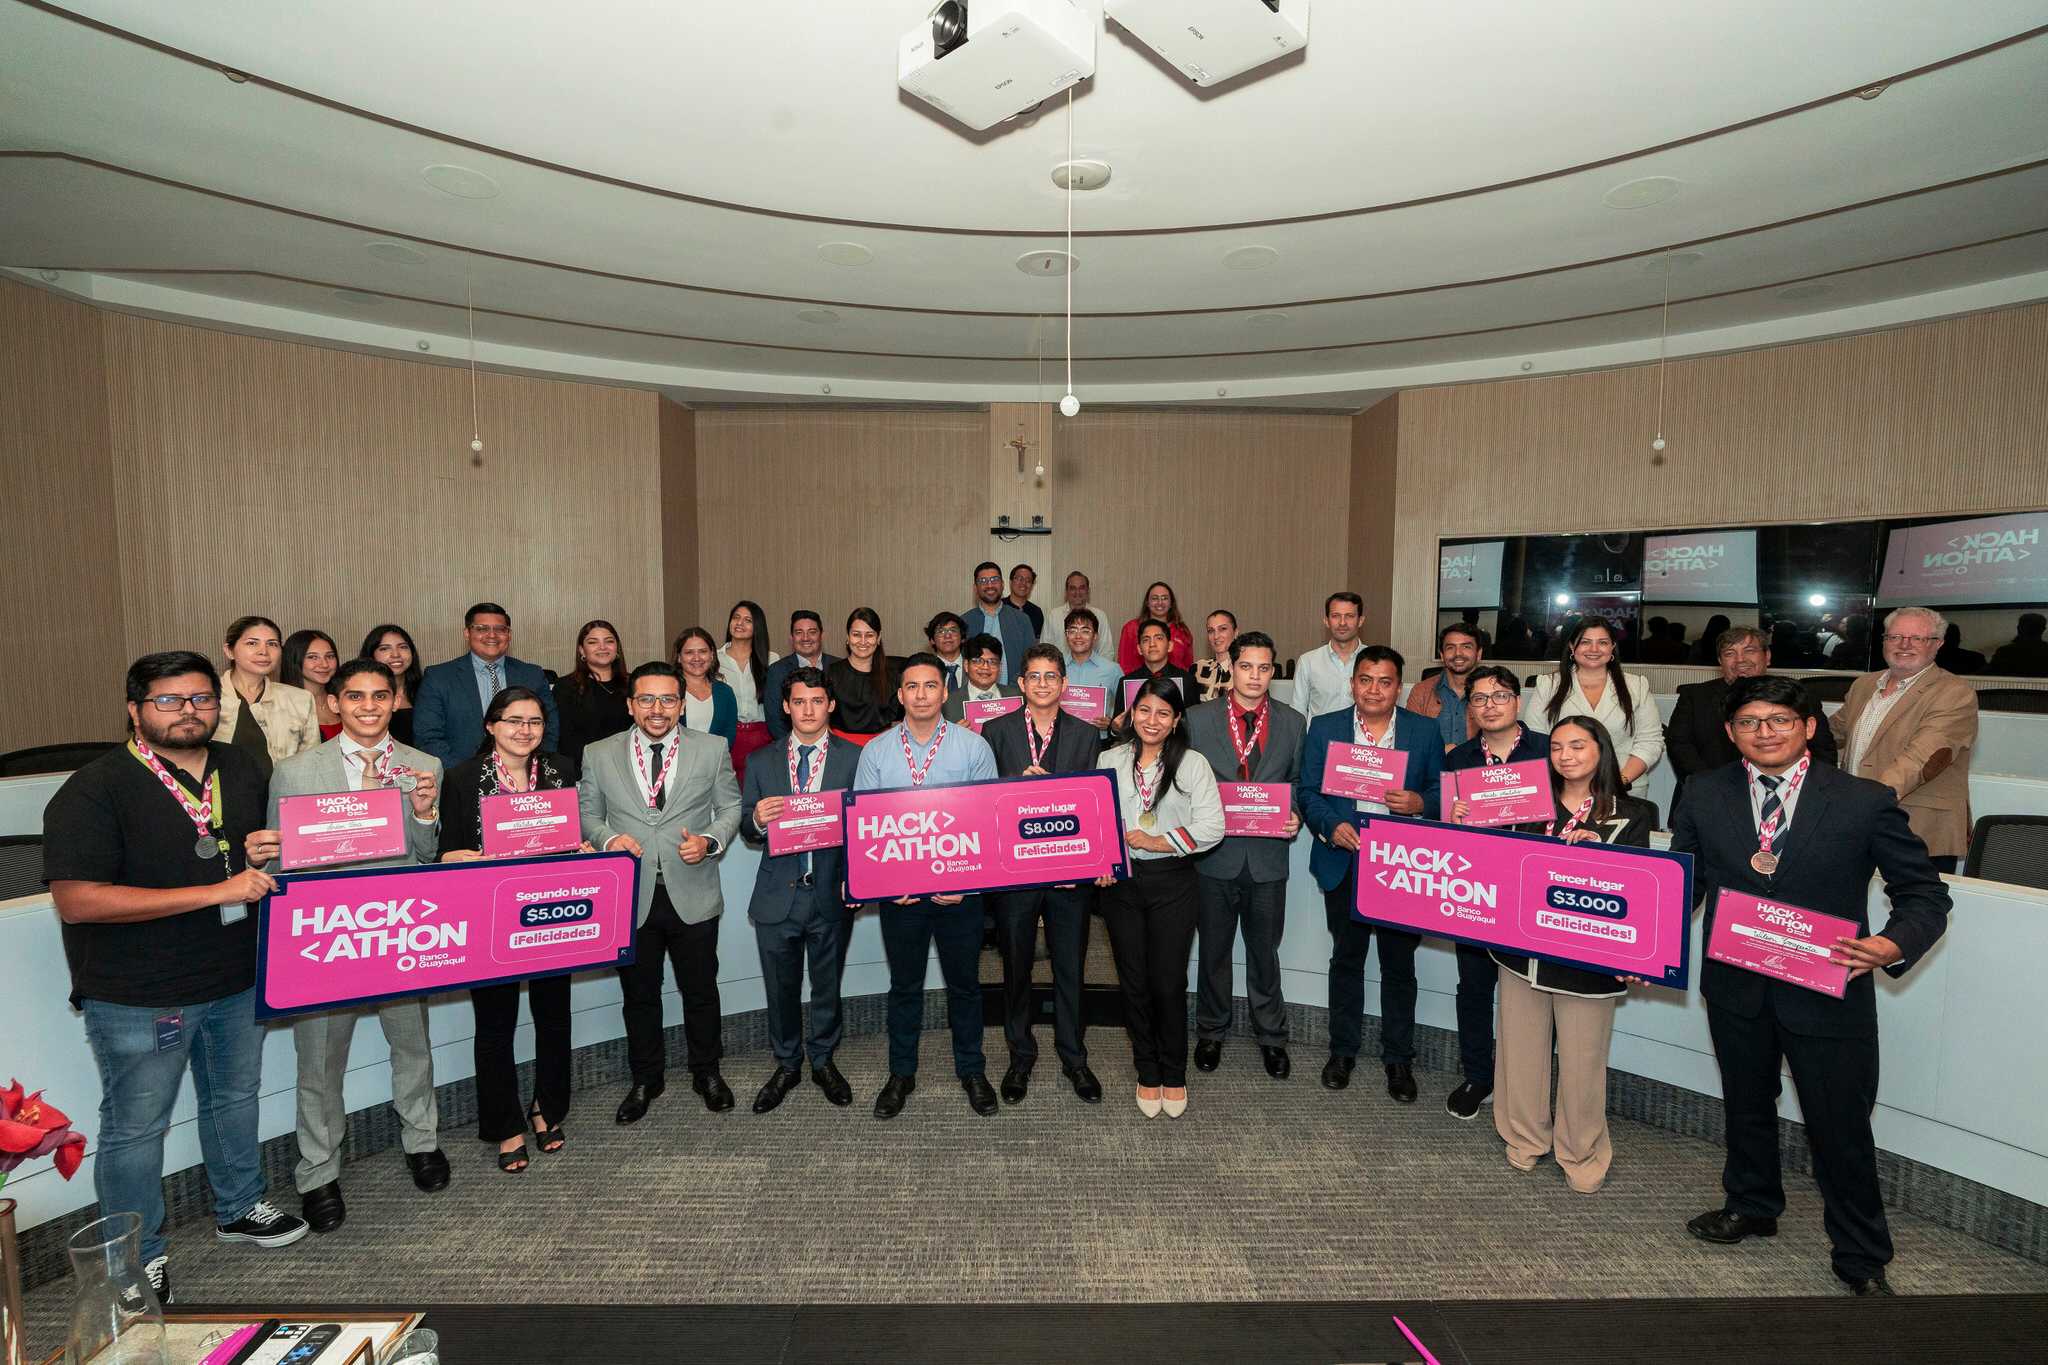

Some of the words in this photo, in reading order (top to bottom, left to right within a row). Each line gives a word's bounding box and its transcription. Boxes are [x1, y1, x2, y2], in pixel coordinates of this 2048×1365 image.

[1018, 805, 1050, 815] Primer
[1052, 802, 1077, 814] lugar
[1024, 820, 1074, 835] $8.000
[1018, 842, 1086, 857] ¡Felicidades!
[1548, 870, 1588, 886] Tercer
[1590, 877, 1624, 892] lugar
[516, 888, 570, 902] Segundo
[572, 886, 600, 898] lugar
[1553, 890, 1620, 913] $3.000
[526, 904, 587, 922] $5.000
[1456, 906, 1481, 916] Banco
[1456, 912, 1496, 925] Guayaquil
[1540, 914, 1632, 940] ¡Felicidades!
[514, 926, 596, 946] ¡Felicidades!
[419, 956, 466, 969] Guayaquil
[420, 952, 448, 962] Banco
